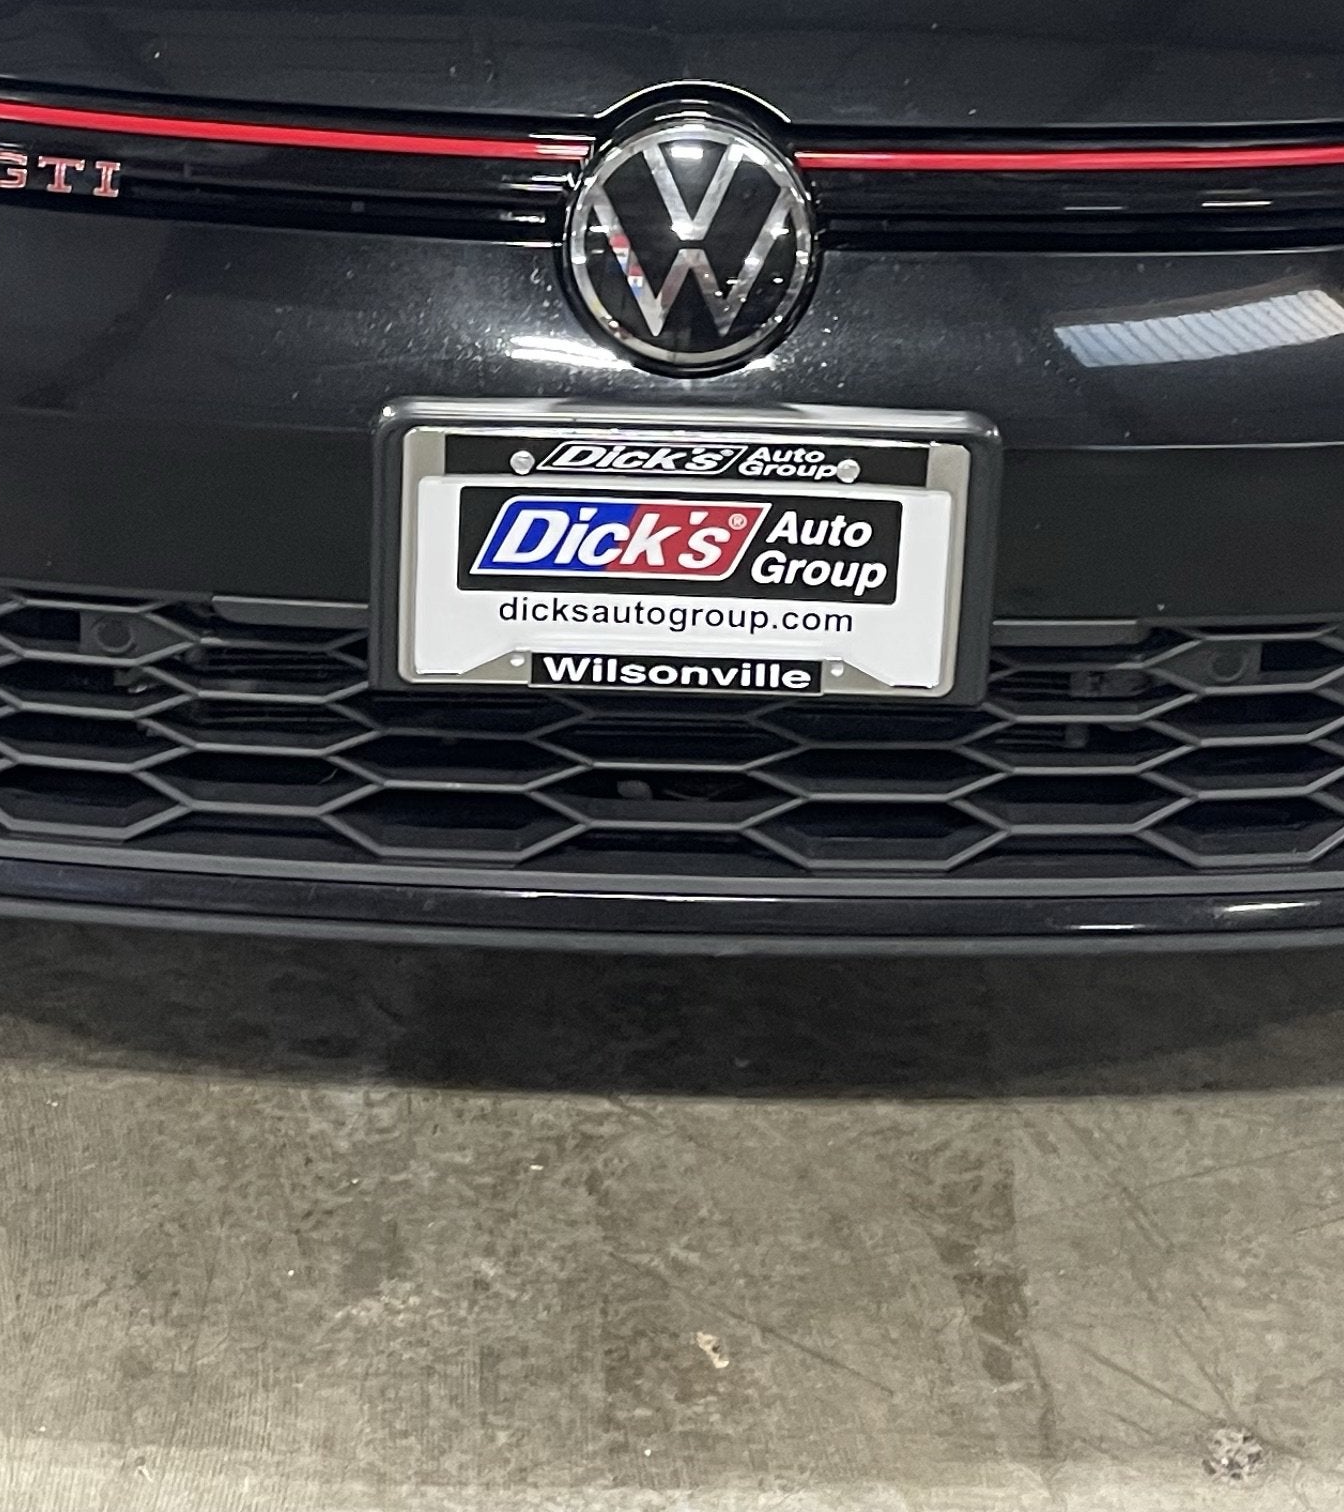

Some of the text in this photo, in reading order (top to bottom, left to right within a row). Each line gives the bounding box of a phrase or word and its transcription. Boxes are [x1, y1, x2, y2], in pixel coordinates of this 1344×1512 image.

[552, 445, 723, 471] Dick's
[738, 460, 838, 481] Group
[746, 446, 825, 464] Auto
[492, 506, 734, 571] Dick's
[765, 511, 873, 548] Auto
[750, 550, 888, 597] Group
[498, 597, 854, 635] dicksautogroup.com
[543, 656, 813, 690] Wilsonville
